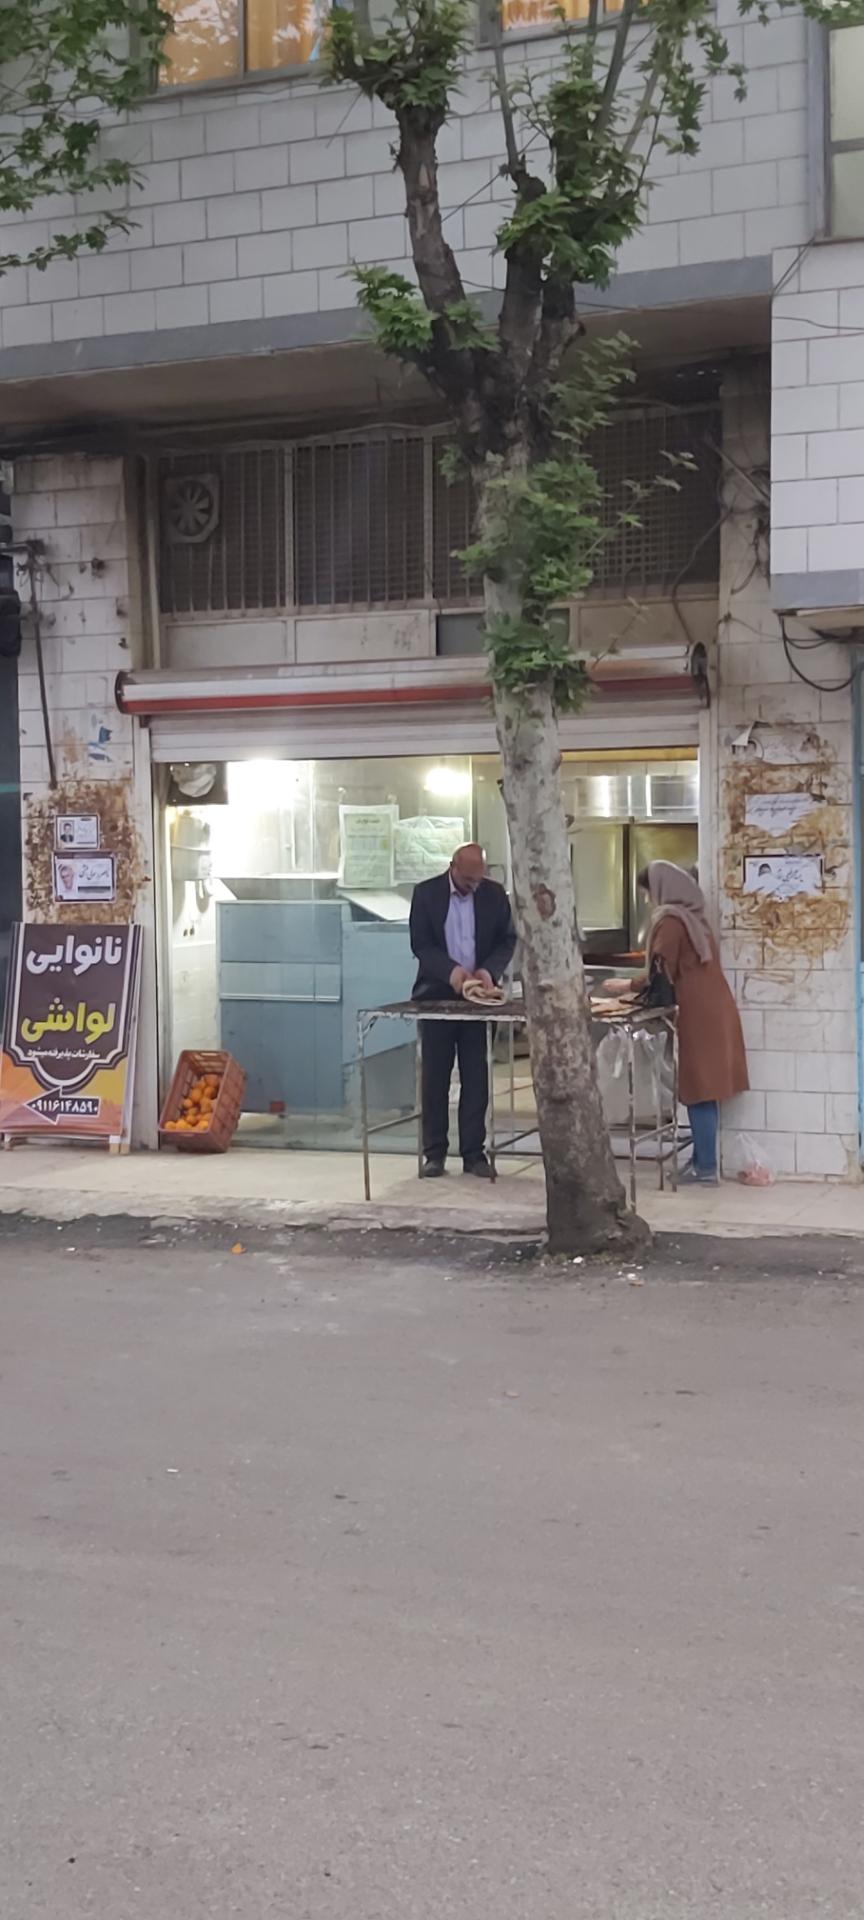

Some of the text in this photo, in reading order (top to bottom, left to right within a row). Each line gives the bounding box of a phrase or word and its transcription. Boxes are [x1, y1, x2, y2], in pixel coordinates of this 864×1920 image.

[26, 935, 122, 975] نانوایی
[21, 997, 116, 1045] لواشی
[31, 1099, 98, 1112] ۰۹۱۱۶۱۴۸۵۹۰
